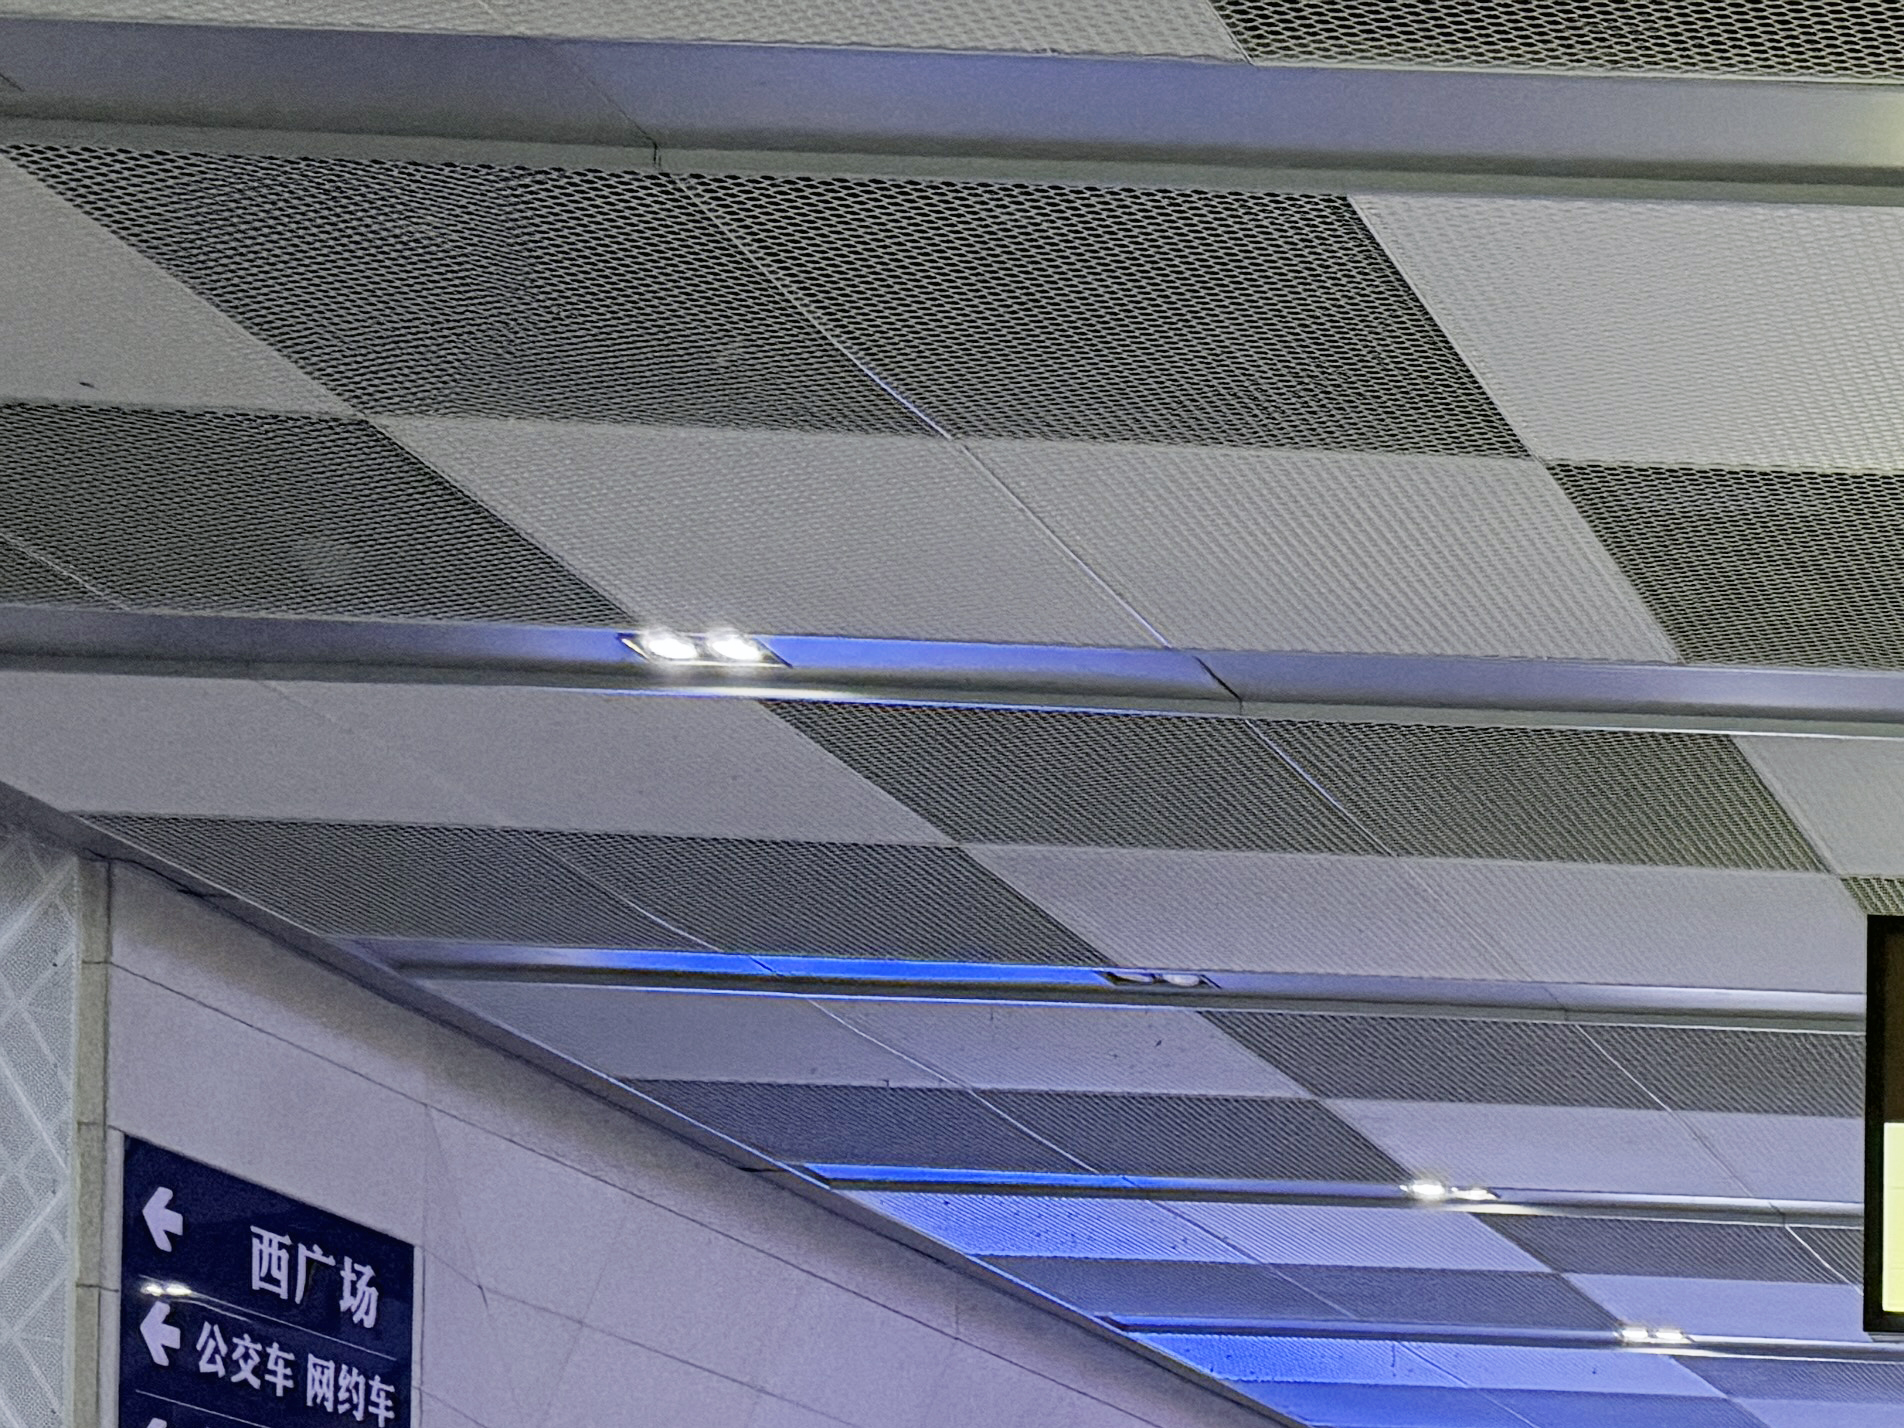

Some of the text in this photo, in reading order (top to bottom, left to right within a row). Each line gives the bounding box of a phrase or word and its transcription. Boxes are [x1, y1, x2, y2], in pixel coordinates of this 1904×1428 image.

[250, 1226, 379, 1329] 西广场
[196, 1321, 396, 1428] 公交车 网约车
